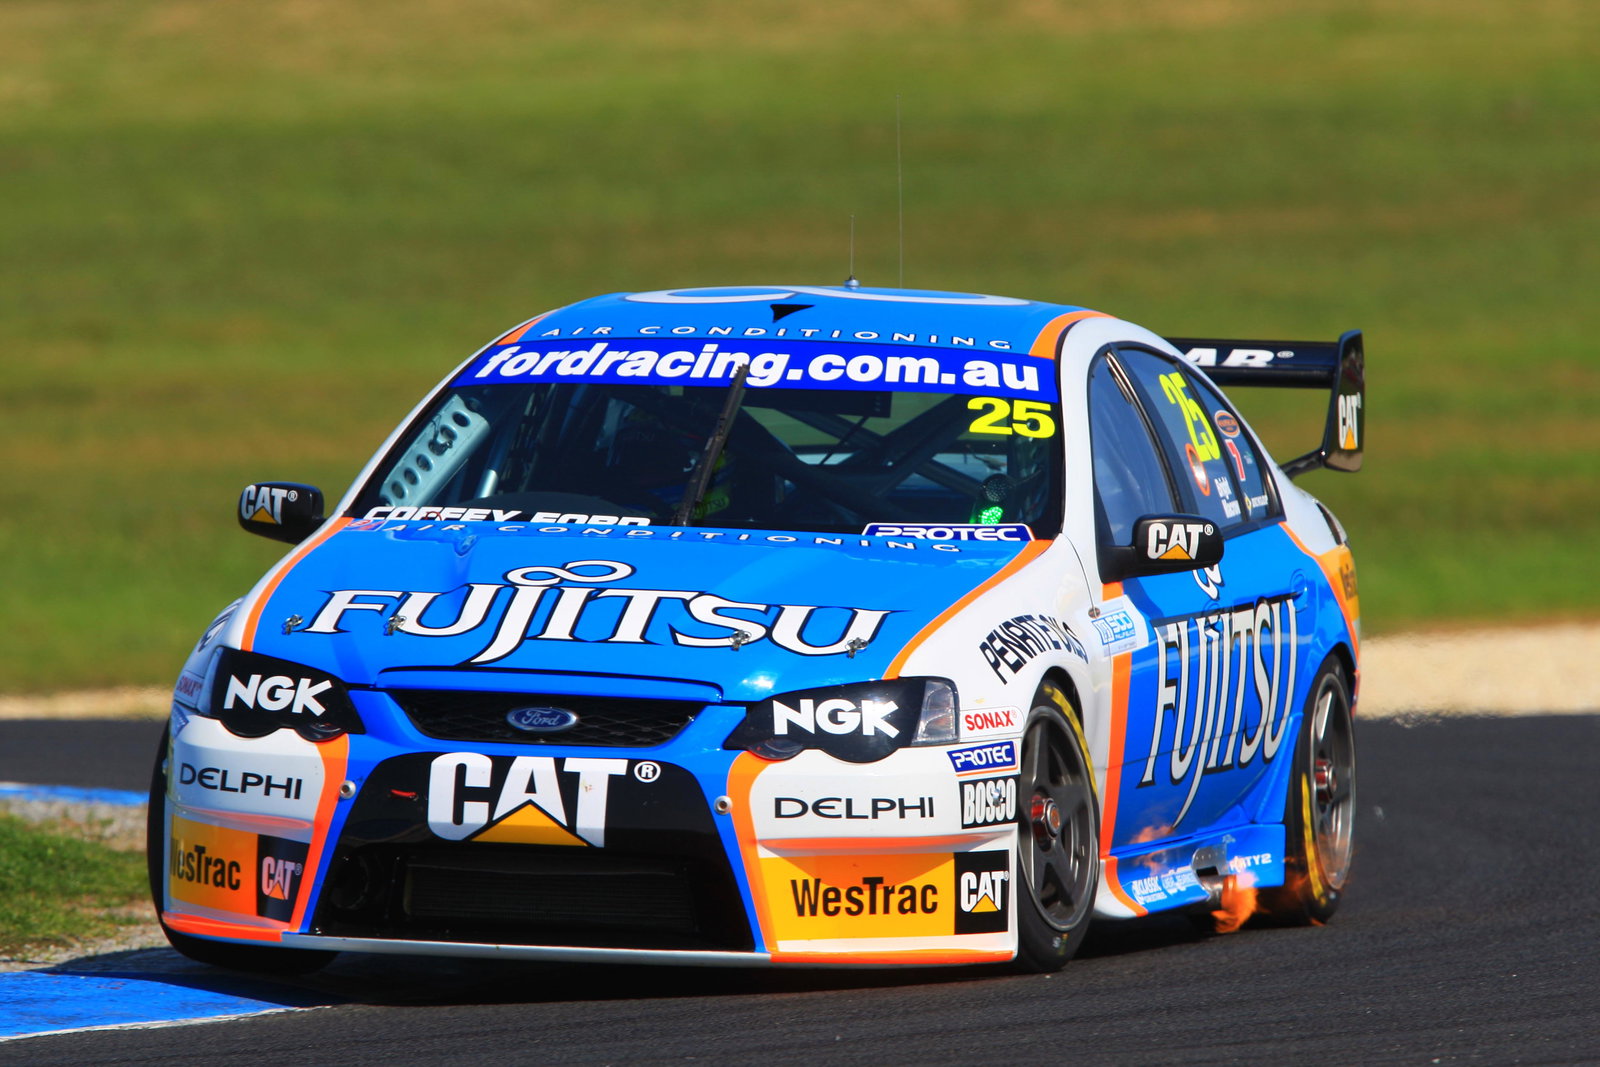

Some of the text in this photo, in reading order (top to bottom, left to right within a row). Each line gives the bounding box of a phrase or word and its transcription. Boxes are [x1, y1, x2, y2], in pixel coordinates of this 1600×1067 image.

[541, 326, 1012, 350] AIR CONDITIONING
[475, 342, 1039, 391] fordracing.com.au
[967, 397, 1055, 438] 25
[1159, 371, 1221, 463] 25
[363, 506, 523, 522] COFFEY
[382, 524, 464, 532] AIR
[498, 526, 960, 552] CONDITIONING
[875, 526, 1021, 541] PROTEC
[303, 583, 900, 665] FUJITSU
[224, 674, 332, 716] NGK
[1140, 597, 1298, 829] FUJITSU
[521, 709, 560, 725] Ford
[772, 699, 900, 739] NGK
[964, 710, 1015, 731] SONAX
[952, 744, 1012, 768] PROTEC
[180, 763, 302, 800] DELPHI
[774, 797, 935, 820] DELPHI
[963, 778, 1016, 825] BOSCO
[790, 877, 938, 917] WesTrac
